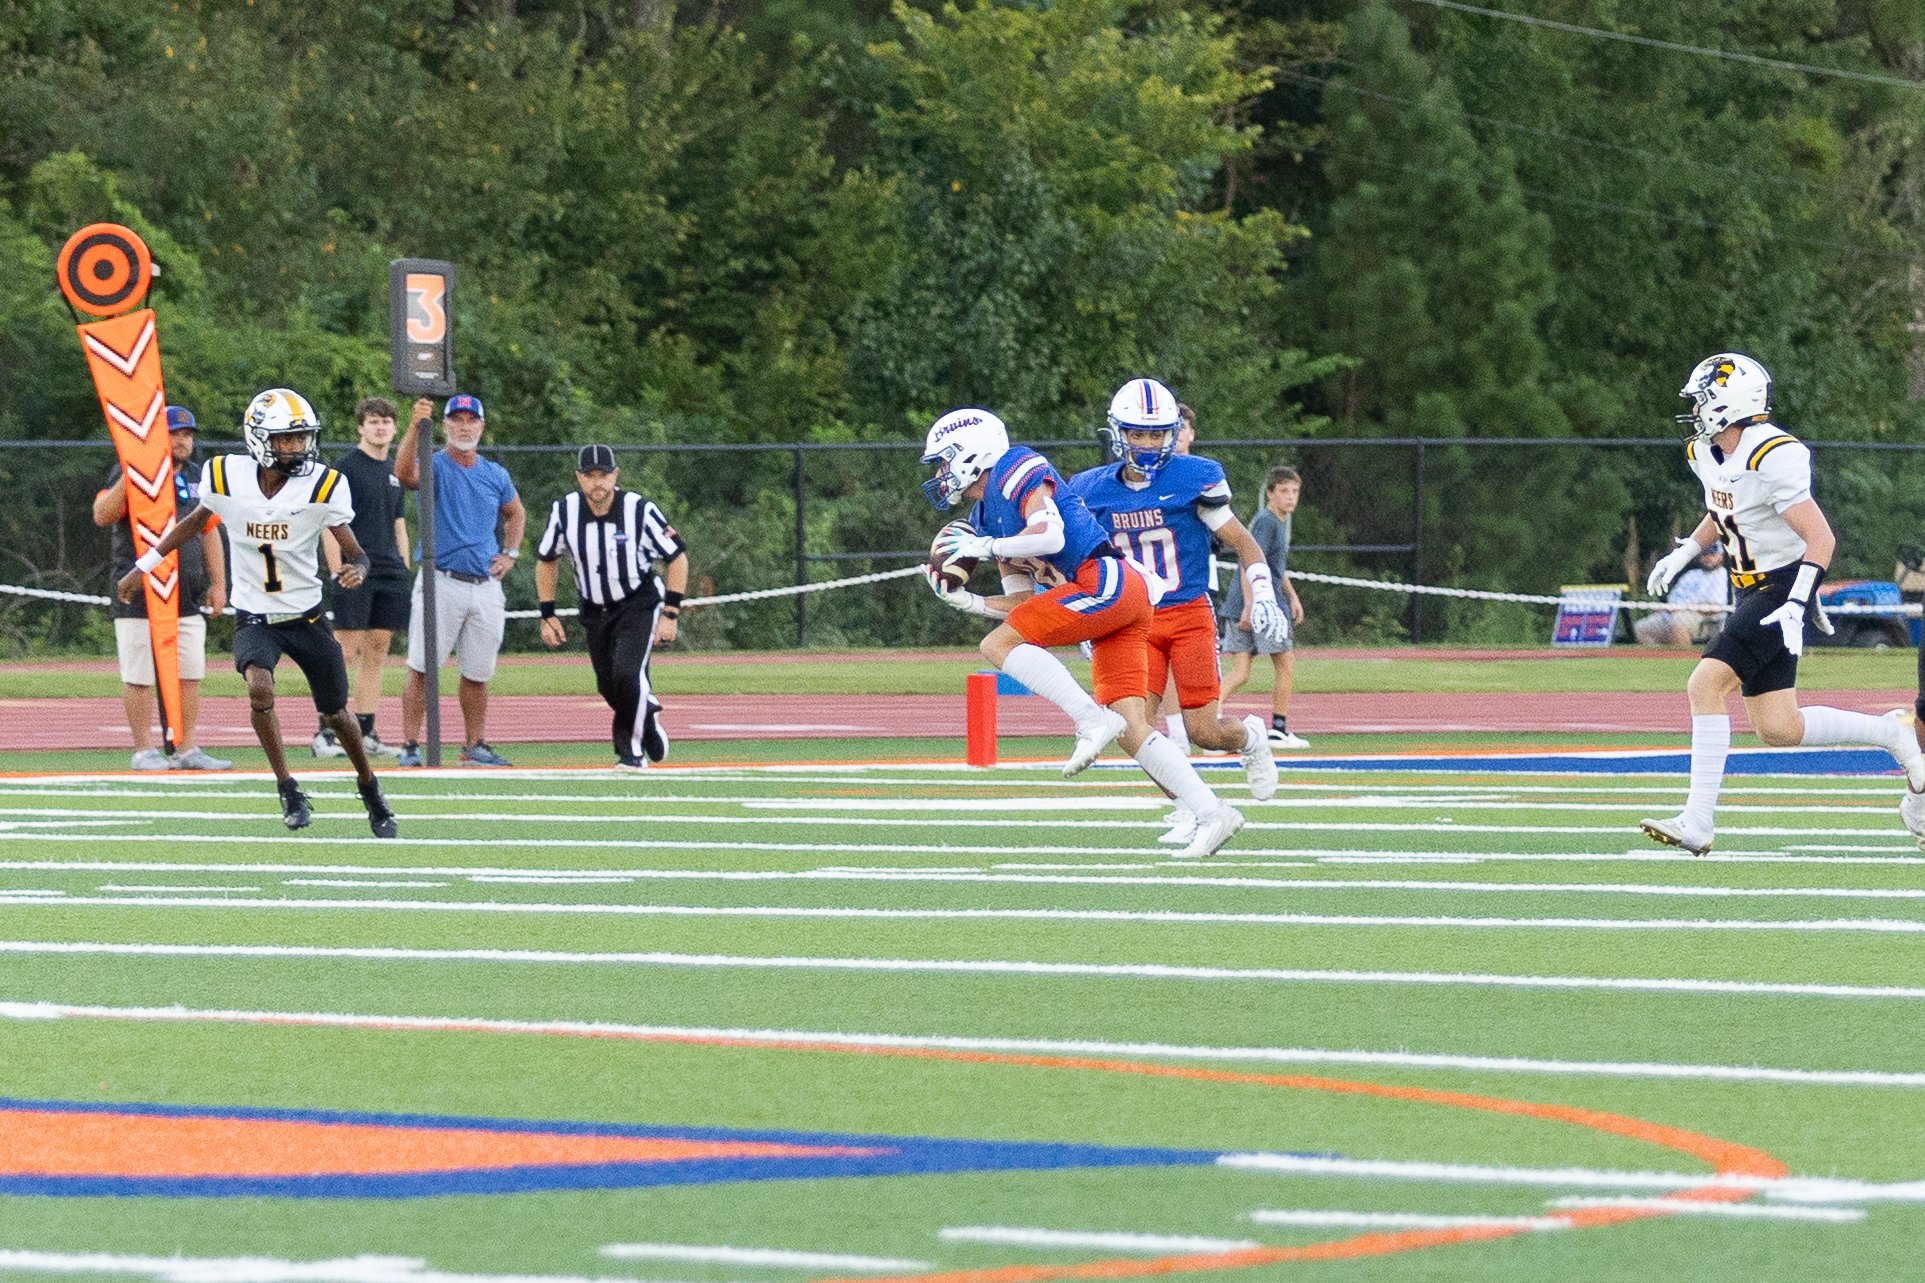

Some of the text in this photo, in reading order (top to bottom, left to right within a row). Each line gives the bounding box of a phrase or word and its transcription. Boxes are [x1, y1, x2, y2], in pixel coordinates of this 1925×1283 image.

[406, 273, 446, 344] 3
[934, 416, 983, 442] Bruins
[246, 522, 289, 540] NEERS
[1111, 508, 1164, 529] BRUINS
[257, 542, 284, 594] 1
